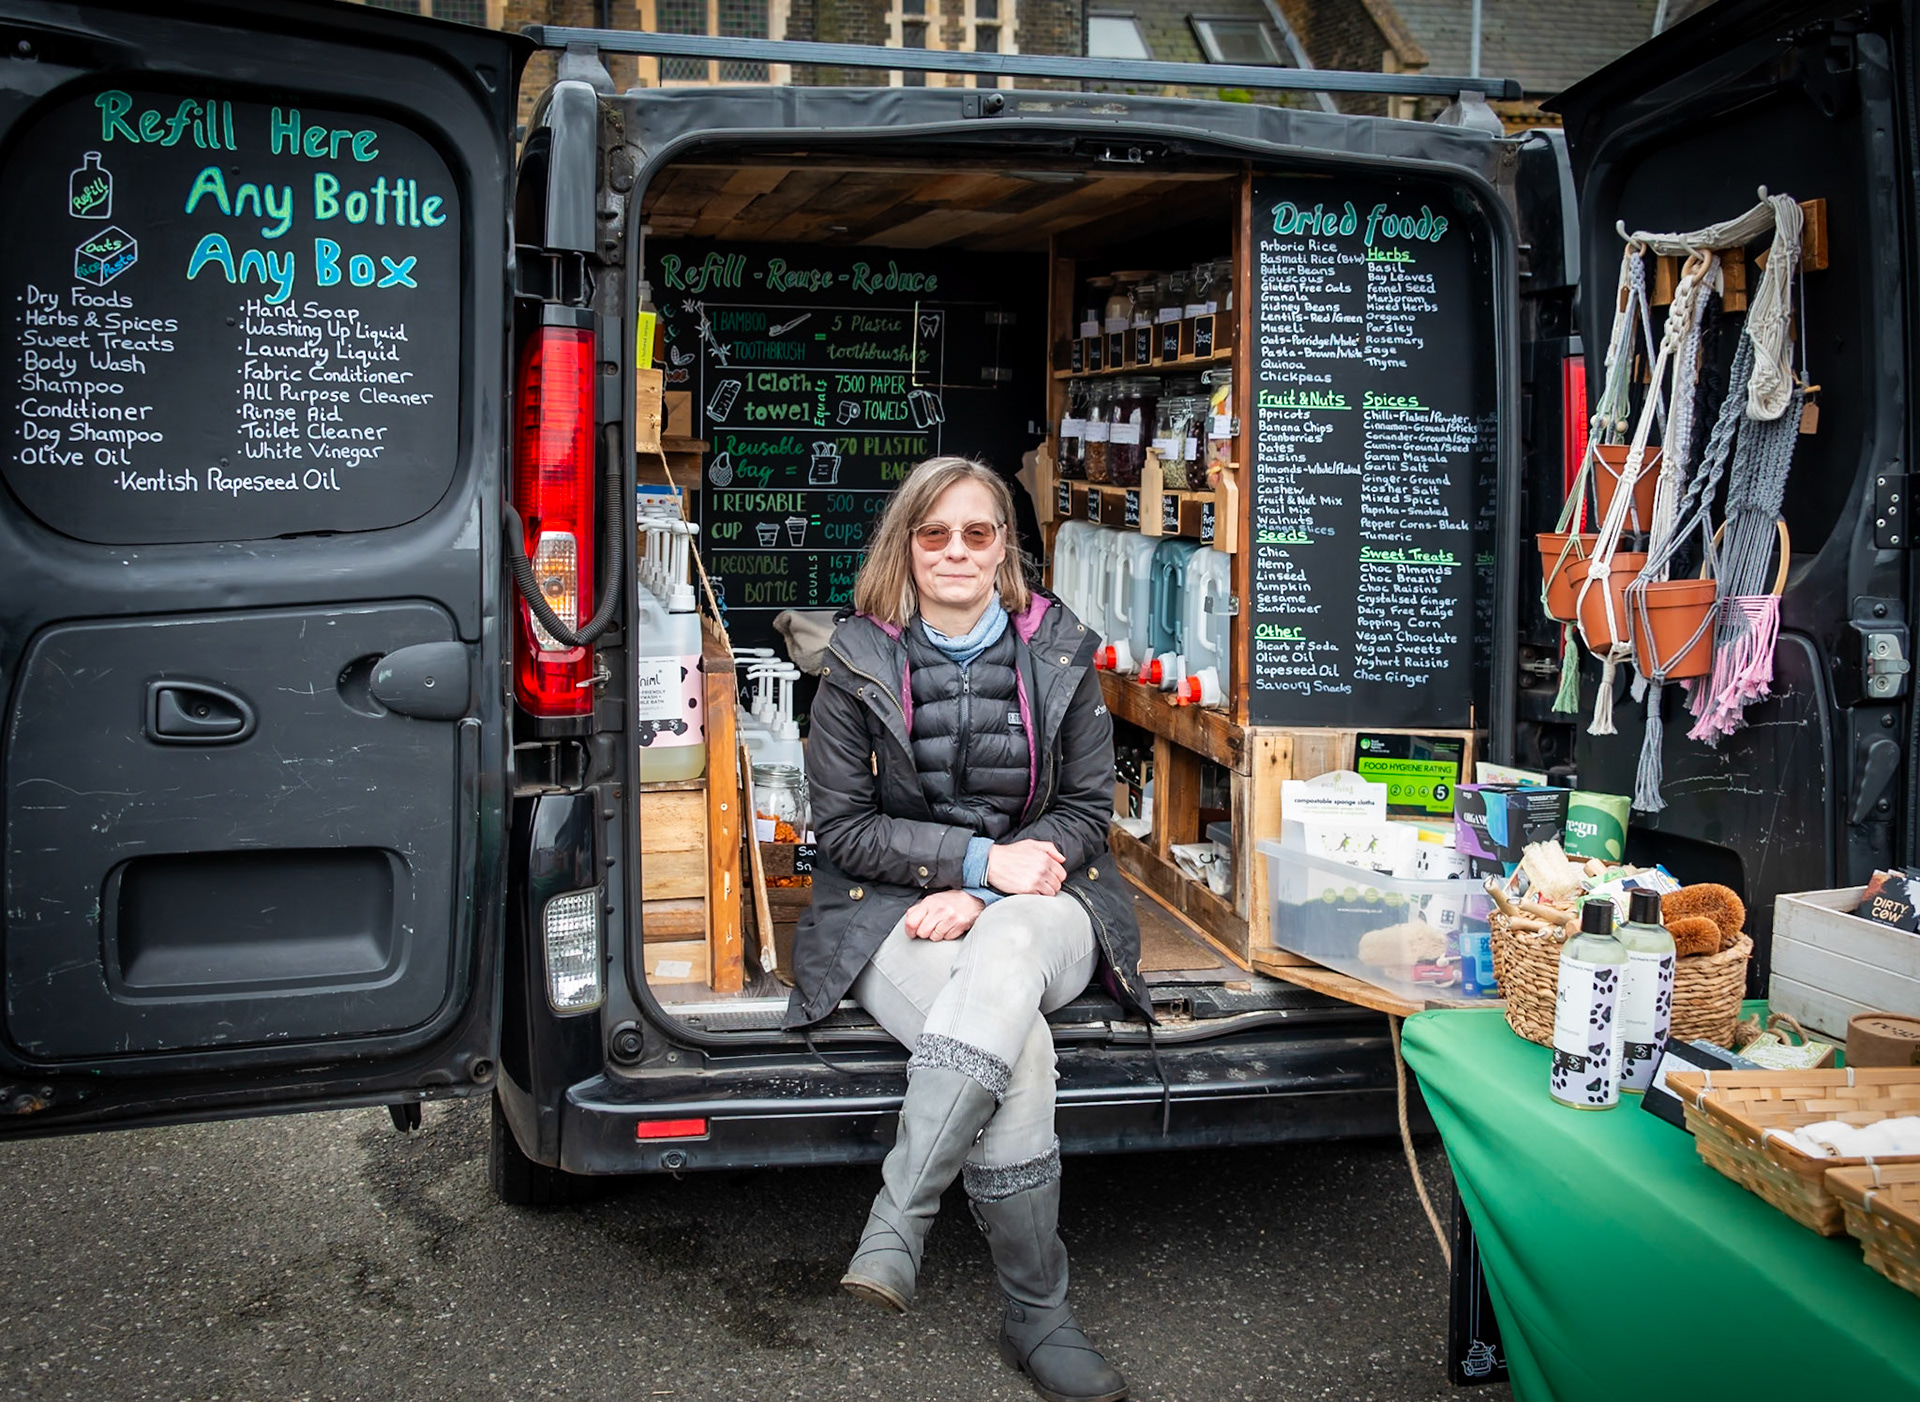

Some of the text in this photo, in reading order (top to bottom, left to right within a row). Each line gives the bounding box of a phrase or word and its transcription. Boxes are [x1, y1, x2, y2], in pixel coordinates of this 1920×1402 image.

[95, 90, 379, 162] Refill Here
[73, 177, 108, 210] Refill
[185, 166, 447, 238] Any Bottle
[1271, 201, 1449, 247] Dried foods
[85, 238, 122, 253] Oats
[1260, 238, 1338, 253] Arborio Rice
[1260, 252, 1336, 264] Basmati Rice
[186, 232, 418, 305] Any Box
[661, 252, 939, 295] Refill Reuse Reduce
[1260, 263, 1336, 277] Butter Beans
[1367, 261, 1406, 274] Basil
[1390, 272, 1434, 283] Leaves
[1405, 282, 1437, 294] Seed
[27, 284, 134, 312] Dry Foods
[1260, 291, 1309, 302] Granola
[246, 299, 360, 325] Hand Soap
[1304, 302, 1341, 312] Beans
[26, 310, 178, 335] Herbs Spices
[720, 311, 903, 333] BAMBOO Plastic
[1365, 312, 1416, 325] Oregano
[245, 317, 409, 348] Washing Up Liquid
[1366, 322, 1414, 337] Parsley
[22, 329, 175, 352] Sweet Treats
[1365, 335, 1424, 350] Rosemary
[244, 337, 400, 368] Laundry Liquid
[733, 340, 807, 361] TOOTHBRUSH
[1363, 345, 1398, 358] Sage
[24, 350, 146, 378] Body Wash
[244, 359, 414, 384] Fabric Conditioner
[1260, 358, 1307, 370] Quinoa
[757, 372, 813, 393] Cloth
[870, 375, 906, 394] PAPER
[1260, 370, 1333, 386] Chickpeas
[21, 372, 124, 400] Shampoo
[243, 382, 434, 406] All Purpose Cleaner
[1259, 388, 1296, 406] Fruit
[1362, 390, 1419, 410] Spices
[20, 398, 154, 421] Conditioner
[744, 379, 829, 428] towel Equals
[862, 400, 909, 422] TOWELS
[242, 402, 344, 422] Rinse Aid
[1258, 408, 1311, 422] Apricots
[240, 421, 388, 441] Toilet Cleaner
[1258, 420, 1301, 432] Banana
[23, 420, 164, 451] Dog Shampoo
[1258, 432, 1323, 443] Cranberries
[726, 435, 929, 457] Reusable PLASTIC
[1258, 442, 1295, 453] Dates
[20, 448, 132, 466] Olive Oil
[245, 441, 385, 468] White Vinegar
[1258, 453, 1307, 463] Raisins
[1363, 450, 1449, 464] Garam Masala
[735, 458, 775, 489] bag
[1400, 461, 1430, 473] Salt
[120, 466, 341, 498] Kentish Rapeseed Oil
[1257, 473, 1296, 484] Brazil
[1257, 483, 1305, 495] Cashew
[1412, 485, 1440, 496] Salt
[722, 492, 854, 513] REUSABLE 500
[1257, 494, 1344, 506] Fruit Mix
[1403, 493, 1440, 507] Spice
[1257, 504, 1285, 515] Trail
[1257, 514, 1314, 525] Walnuts
[1360, 517, 1396, 532] Pepper
[711, 522, 744, 540] CUP
[1257, 545, 1290, 558] Chia
[1360, 545, 1454, 562] Sweet Treats
[1257, 557, 1294, 573] Hemp
[1359, 562, 1452, 576] Choc Almonds
[720, 554, 852, 606] REUSABLE EQUALS 167
[1255, 568, 1307, 582] Linseed
[1360, 573, 1442, 584] Choc Brazils
[745, 581, 799, 602] BOTTLE
[1256, 581, 1312, 595] Pumpkin
[1358, 583, 1438, 594] Choc Raisins
[1256, 593, 1307, 604] Sesame
[1356, 593, 1458, 609] Crystalised Ginger
[1256, 603, 1322, 614] Sunflower
[1357, 605, 1415, 618] Dairy Free
[1357, 616, 1441, 632] Popping Corn
[1355, 630, 1458, 645] Vegan Chocolate
[1256, 640, 1339, 651] Bicarb Soda
[1355, 643, 1442, 656] Vegan Sweets
[1255, 651, 1315, 663] Olive Oil
[1354, 655, 1449, 670] Yoghurt Raisins
[1255, 664, 1317, 678] Rapeseed
[1353, 668, 1430, 688] Choc Ginger
[1255, 678, 1352, 696] Savoury Snacks
[1363, 761, 1453, 774] FOOD HYGIENE RATING
[1436, 785, 1446, 800] 5
[1334, 798, 1356, 806] sponge
[1872, 896, 1909, 914] DIRTY
